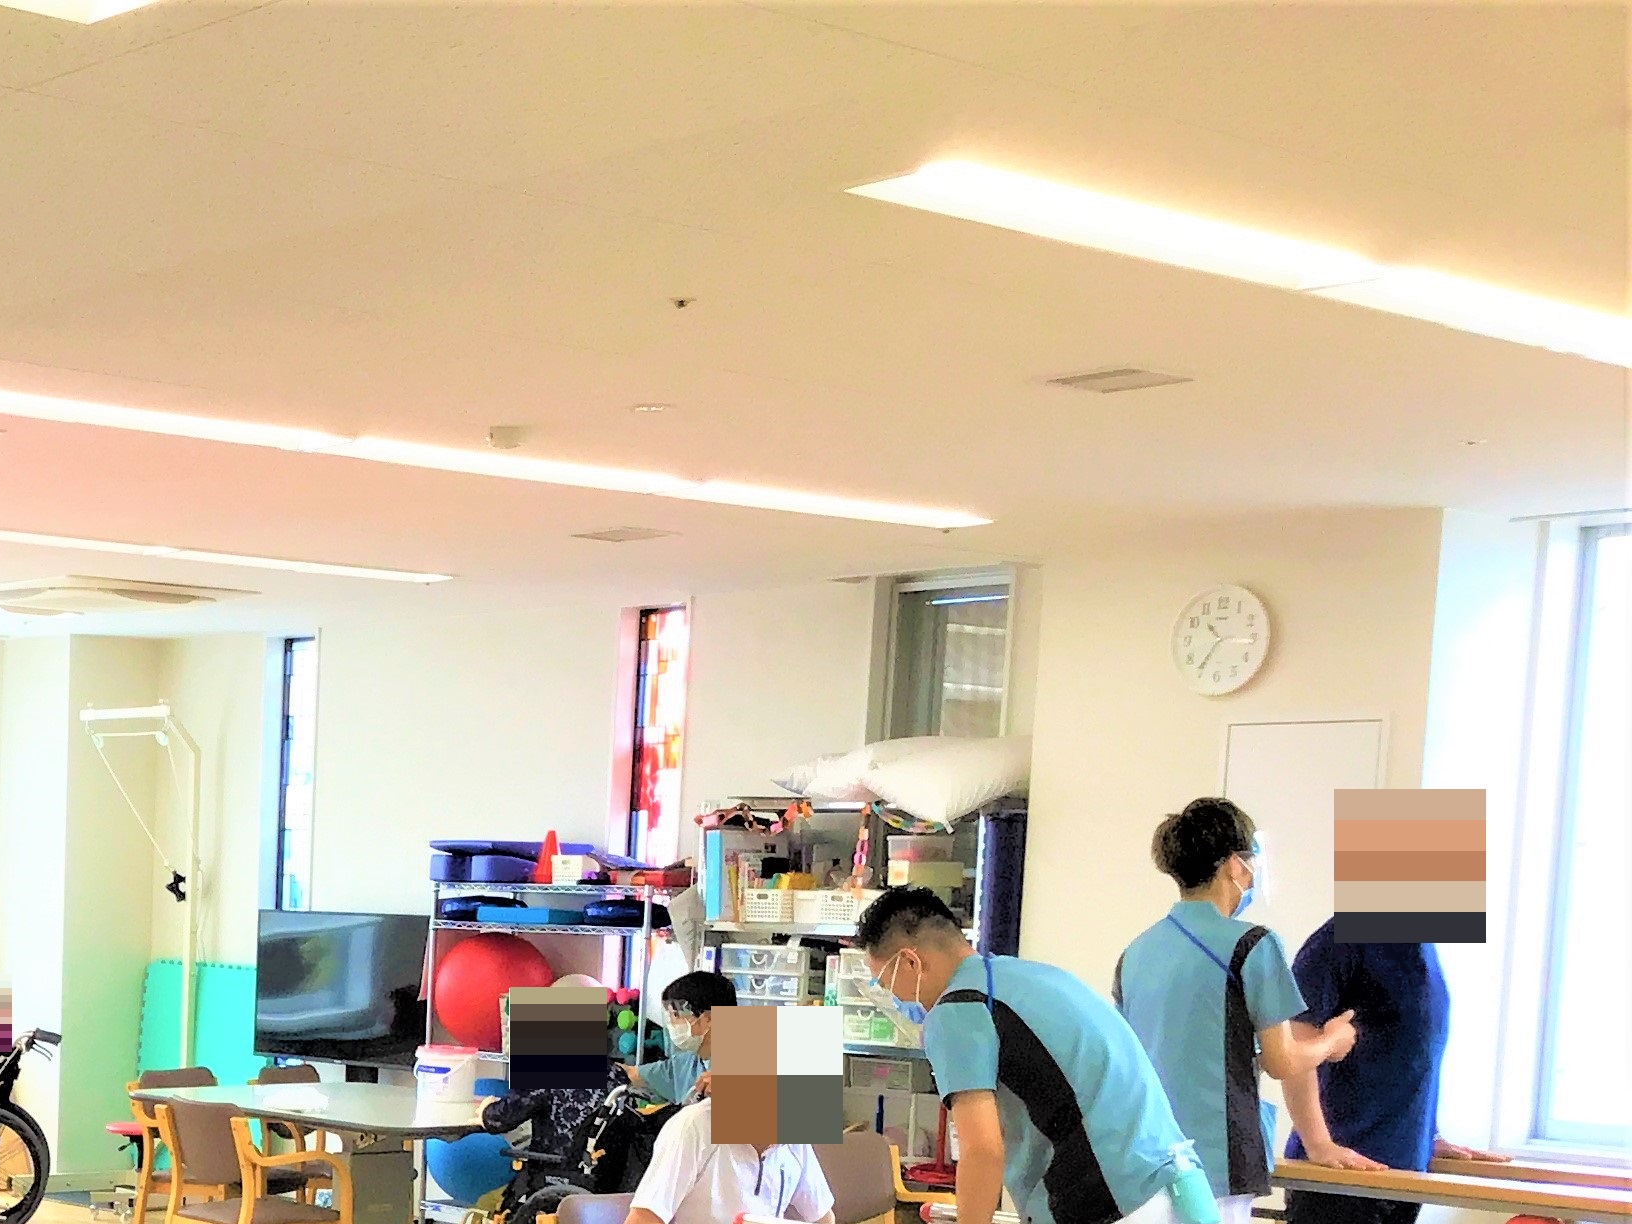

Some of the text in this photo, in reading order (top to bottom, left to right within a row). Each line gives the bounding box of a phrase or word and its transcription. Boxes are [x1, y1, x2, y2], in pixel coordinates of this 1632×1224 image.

[1202, 602, 1211, 615] 11
[1217, 596, 1230, 609] 12
[1189, 616, 1200, 629] 10
[1212, 670, 1221, 683] 6
